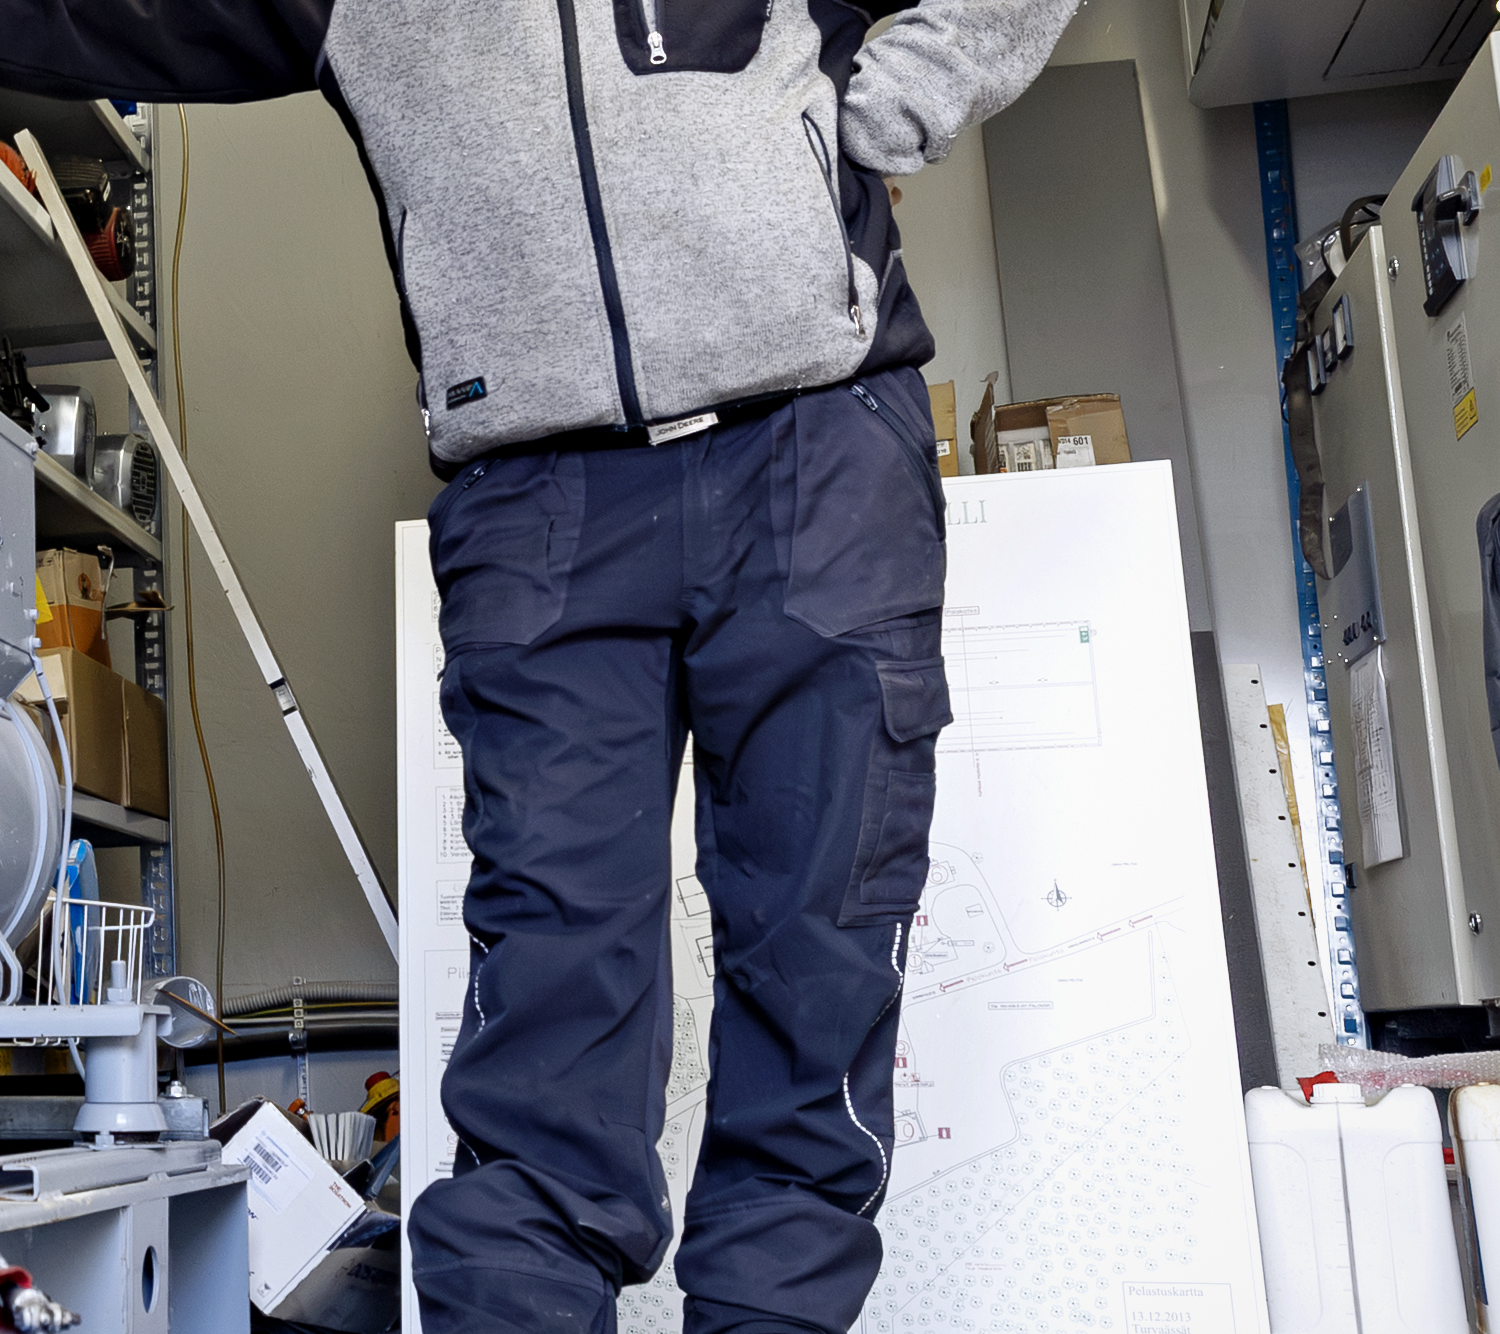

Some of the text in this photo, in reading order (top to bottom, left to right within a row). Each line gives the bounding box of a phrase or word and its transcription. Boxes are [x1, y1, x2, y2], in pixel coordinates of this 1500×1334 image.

[656, 417, 704, 436] JOHN DEERE
[1072, 436, 1089, 446] 601
[1128, 1286, 1204, 1297] Pelastuskartta
[1132, 1311, 1191, 1322] 13.12.2013
[1132, 1324, 1191, 1334] Turvaässät
